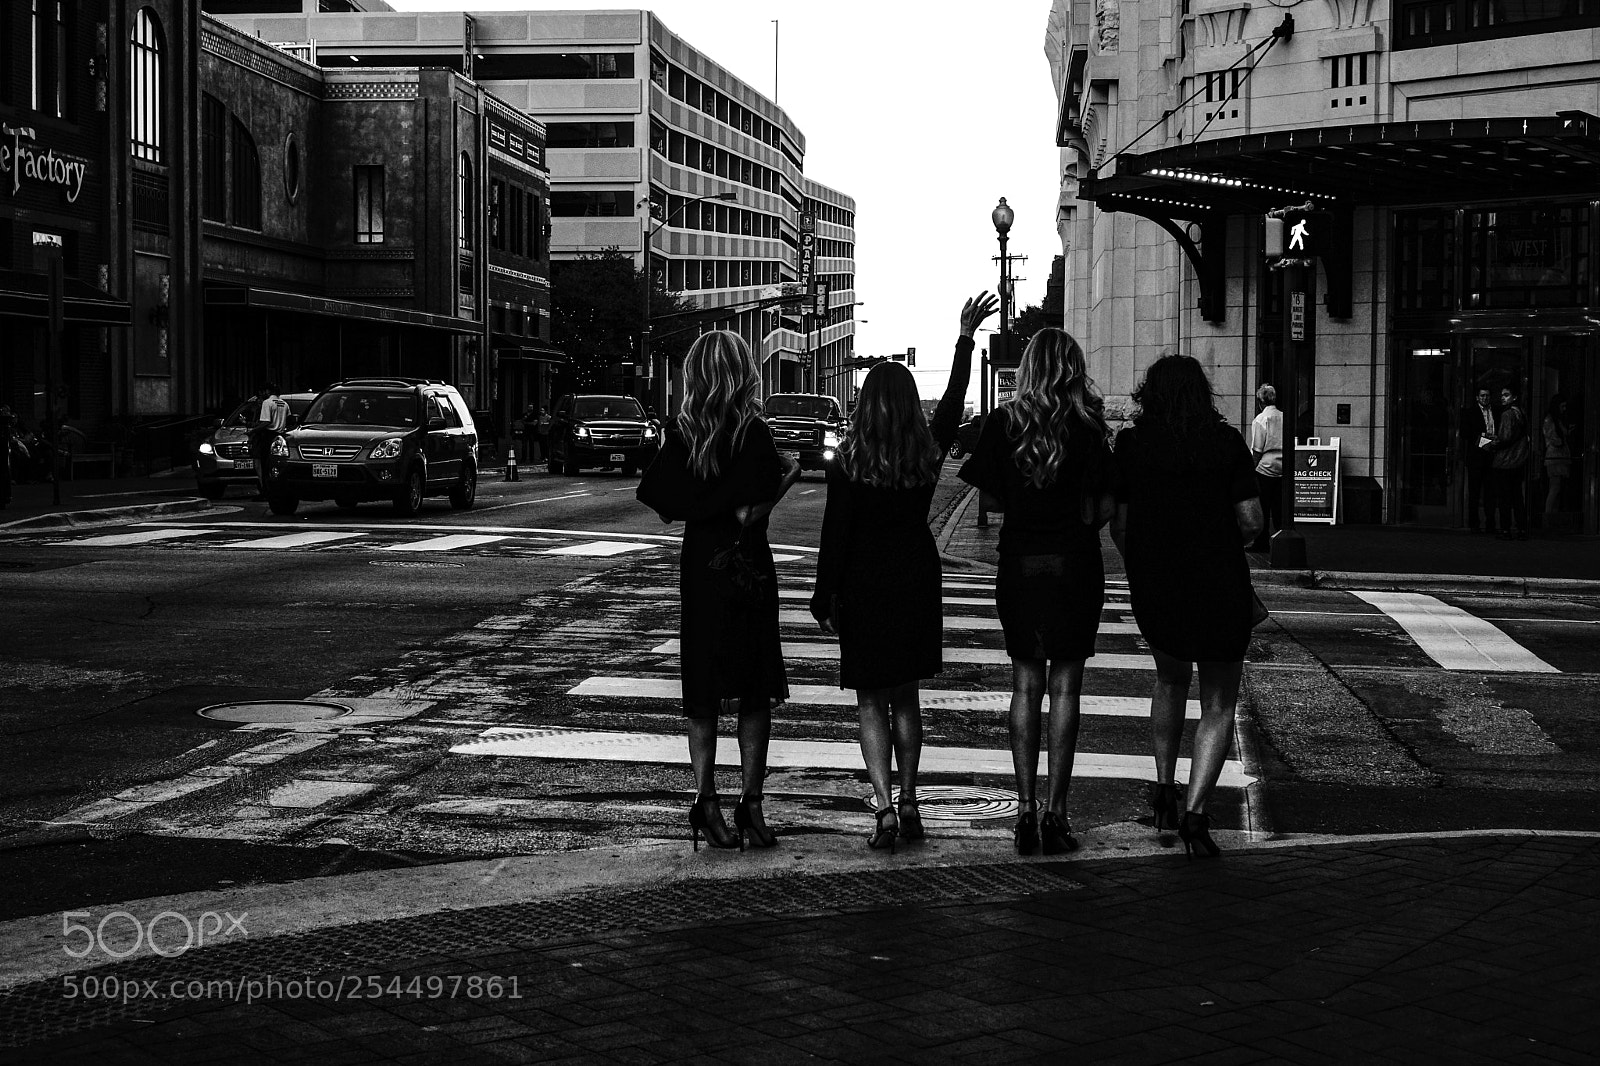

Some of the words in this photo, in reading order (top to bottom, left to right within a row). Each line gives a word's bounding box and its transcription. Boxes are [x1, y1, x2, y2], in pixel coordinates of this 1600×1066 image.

[706, 100, 713, 113] 5
[744, 120, 750, 131] 6
[657, 139, 664, 153] 4
[3, 121, 85, 203] Factory
[706, 156, 713, 170] 4
[657, 205, 663, 219] 3
[706, 213, 712, 226] 3
[1511, 240, 1547, 257] WEST
[801, 235, 813, 286] PARK
[656, 270, 663, 284] 2
[706, 269, 712, 282] 2
[743, 270, 749, 280] 3
[773, 272, 778, 282] 3
[773, 316, 778, 326] 2
